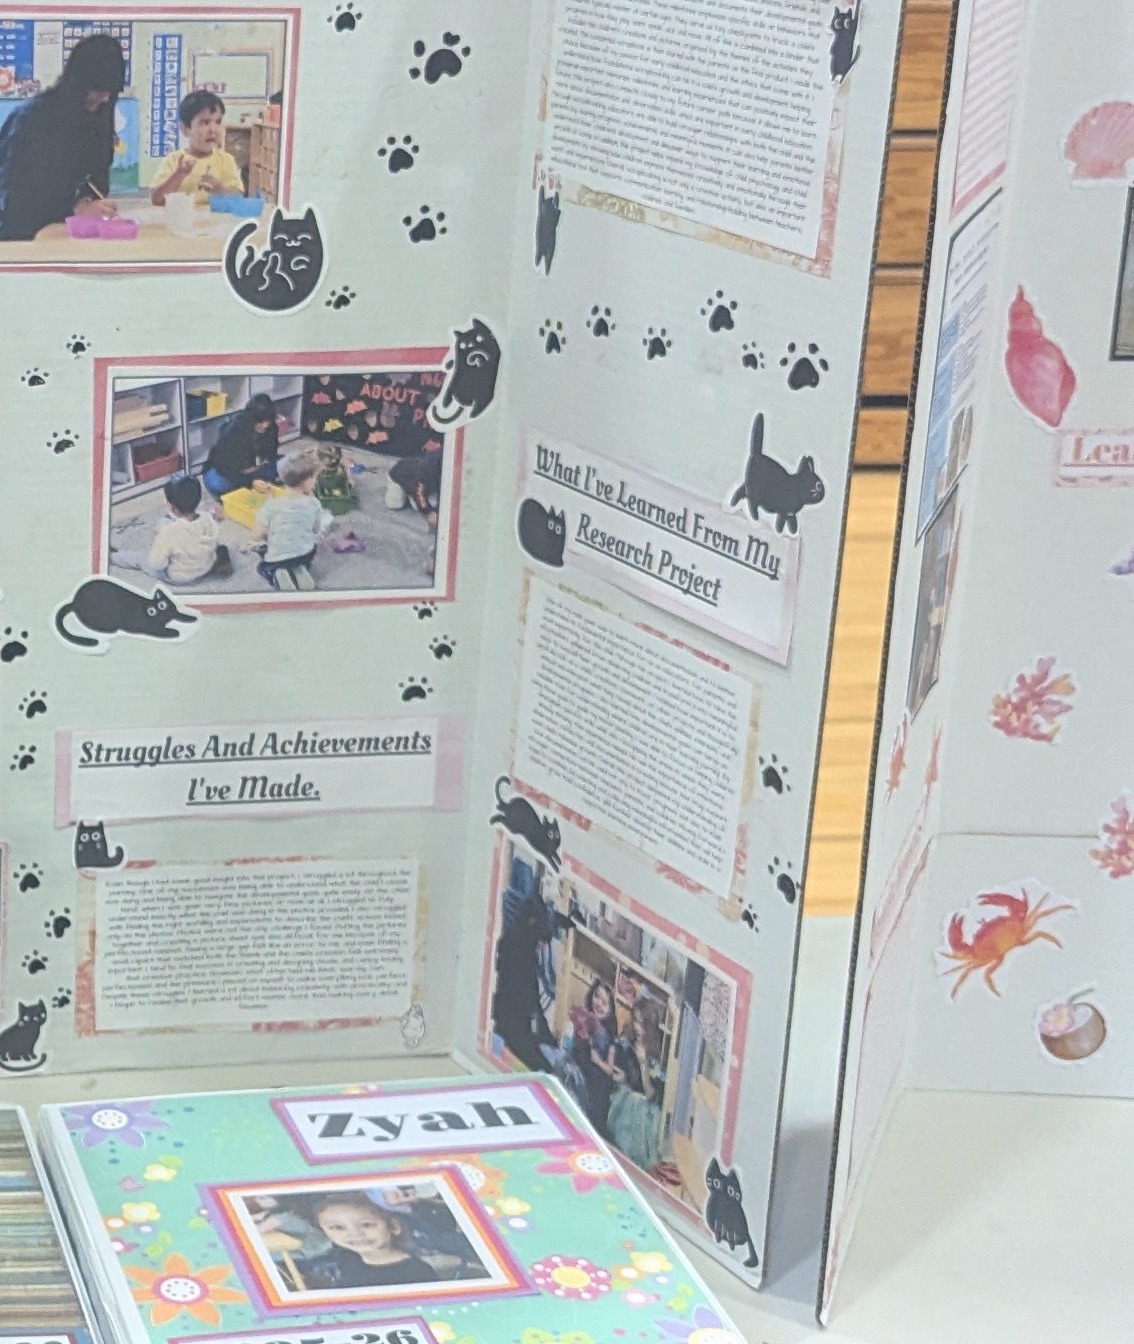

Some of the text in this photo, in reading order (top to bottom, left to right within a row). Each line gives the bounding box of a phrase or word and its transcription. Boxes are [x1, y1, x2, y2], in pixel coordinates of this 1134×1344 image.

[360, 383, 421, 406] ABOUT
[535, 443, 781, 581] What I've Learned From My
[576, 513, 722, 601] Research Project
[79, 729, 431, 768] Struggles And Achievements
[187, 773, 320, 801] I've Made.
[307, 1096, 539, 1142] Zyah
